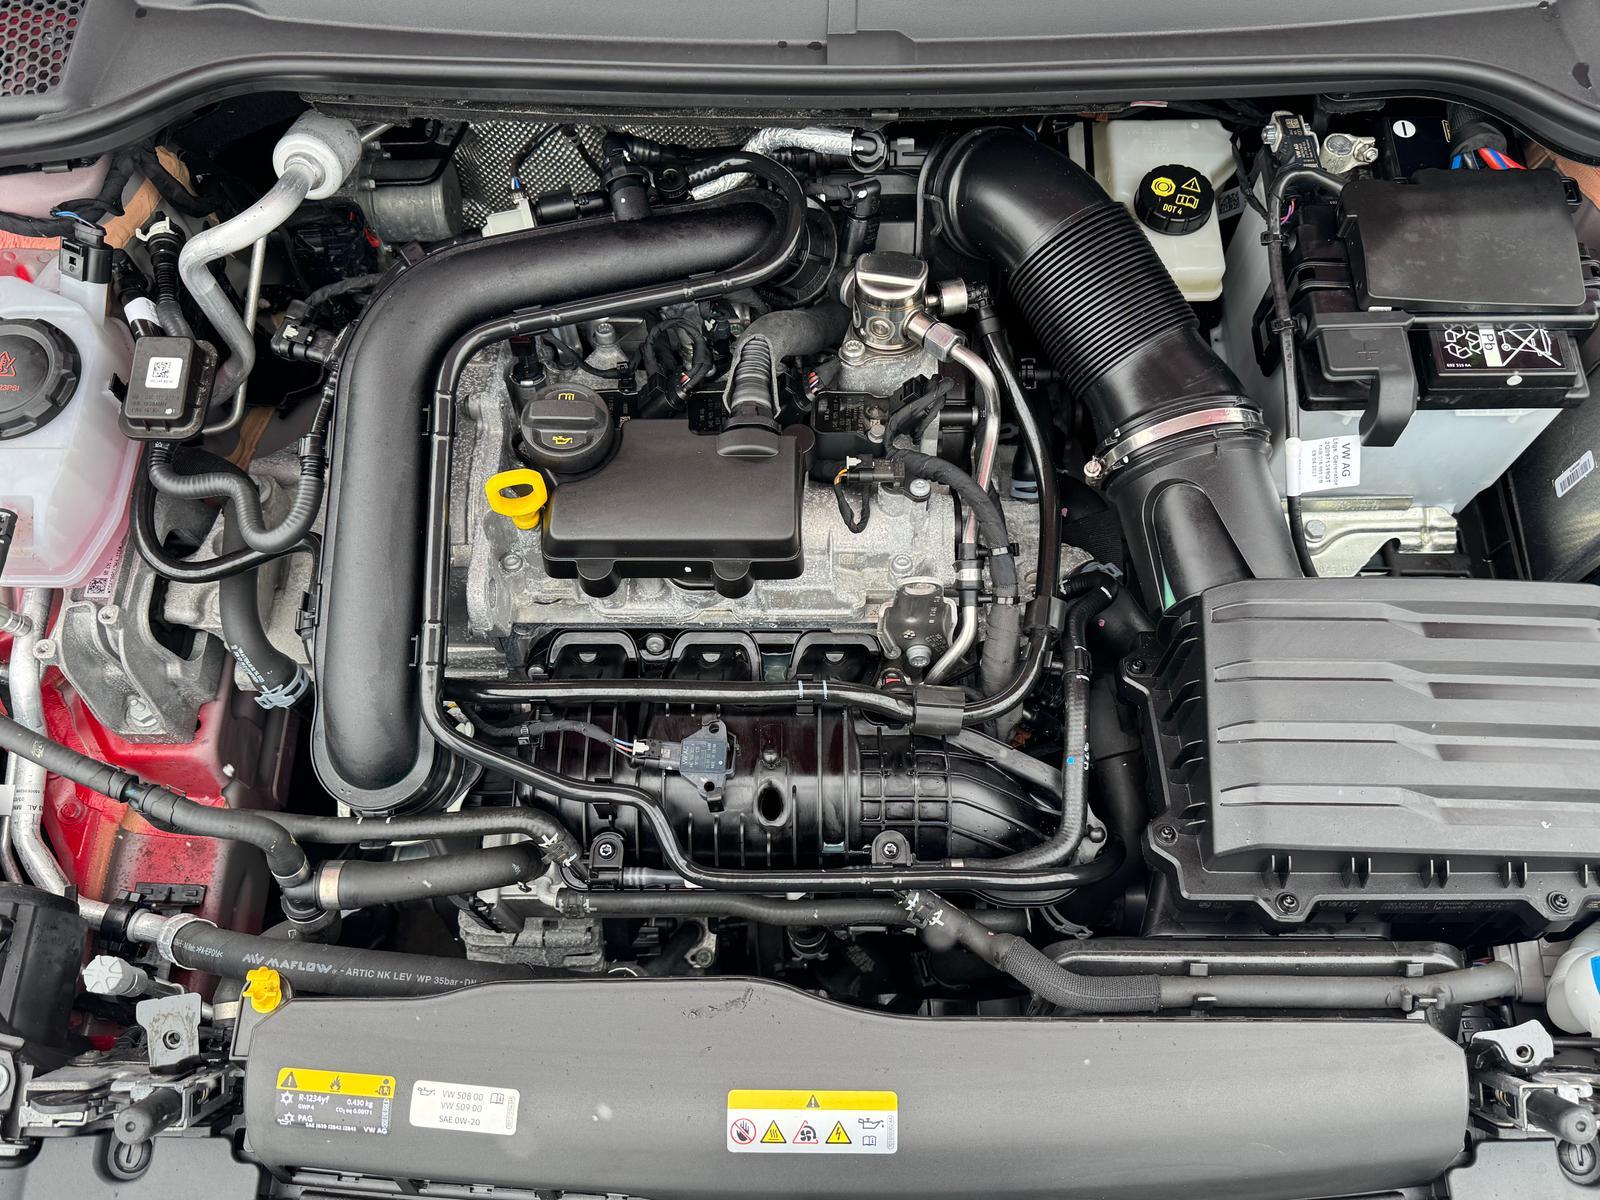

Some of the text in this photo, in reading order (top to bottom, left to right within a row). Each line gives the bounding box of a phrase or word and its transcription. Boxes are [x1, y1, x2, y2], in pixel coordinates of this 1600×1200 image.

[1162, 203, 1183, 215] DOT 4
[1481, 333, 1496, 351] Pb
[1341, 442, 1351, 477] VW AG
[264, 957, 333, 974] MAFLOW
[376, 970, 391, 980] NK
[393, 972, 413, 982] LEV
[298, 1093, 374, 1109] R-1234yf 0.430 kg
[442, 1090, 484, 1101] VW 508 00
[441, 1102, 483, 1112] VW 509 00
[297, 1114, 313, 1122] PAG
[439, 1114, 481, 1126] SAE 0W-20
[362, 1126, 376, 1134] VW
[376, 1127, 388, 1135] AG
